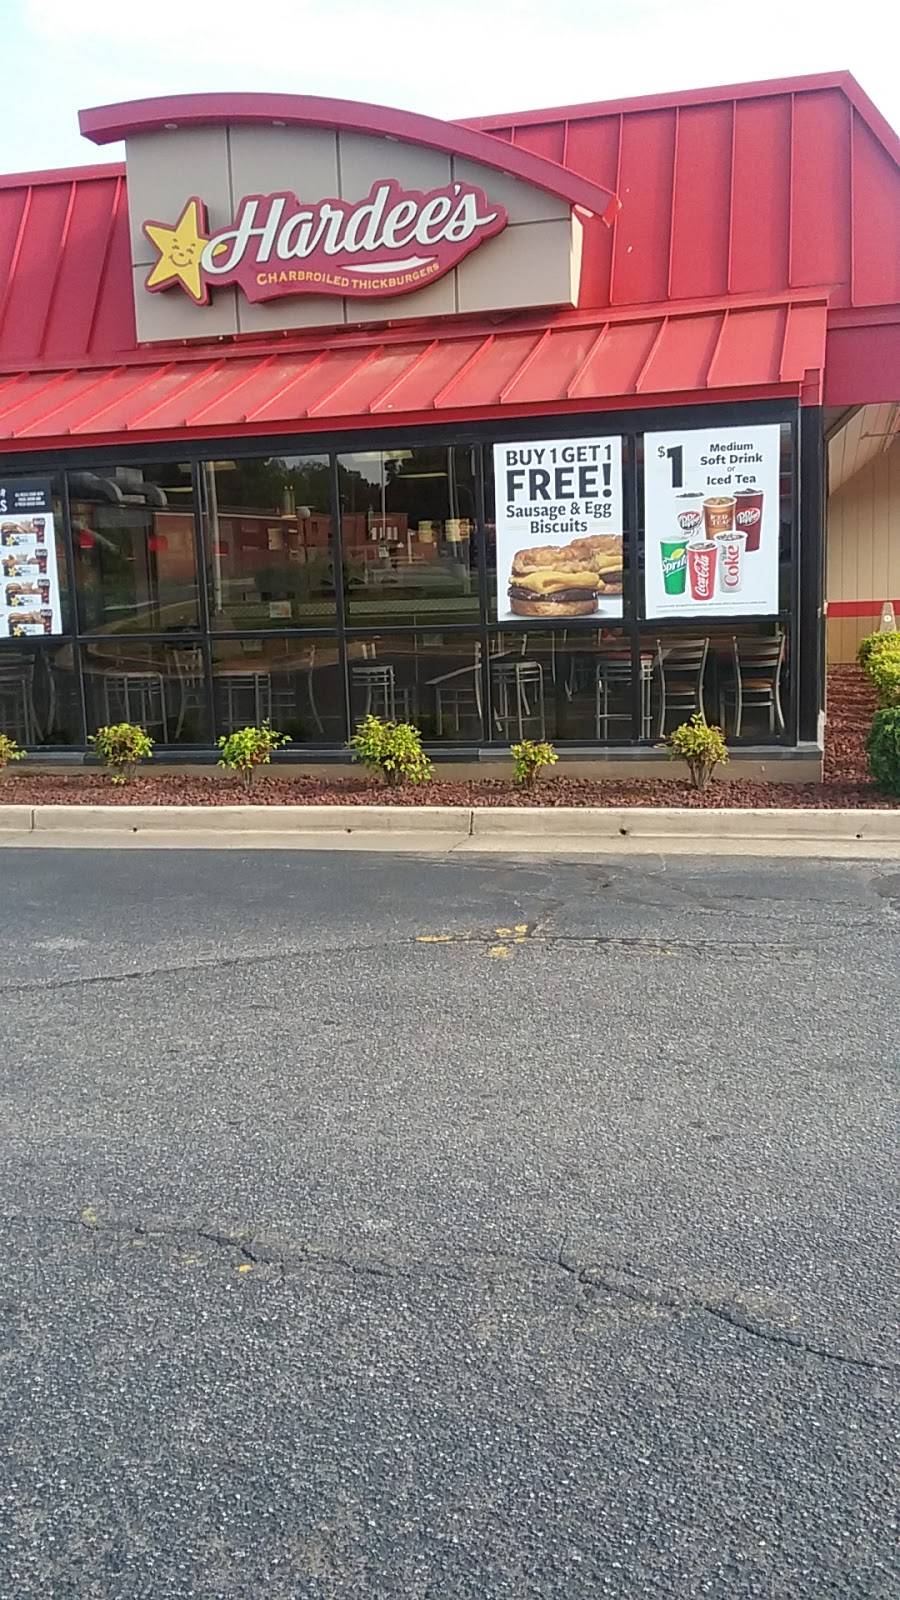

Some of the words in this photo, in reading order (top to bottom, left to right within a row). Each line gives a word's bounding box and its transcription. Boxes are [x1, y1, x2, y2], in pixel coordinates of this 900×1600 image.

[201, 183, 497, 274] Hardee's
[256, 270, 349, 287] CHARBROILED
[351, 263, 440, 289] THICKBURGERS
[506, 448, 545, 466] BUY
[549, 448, 557, 464] 1
[561, 444, 601, 463] GET
[604, 444, 612, 461] 1
[709, 441, 754, 452] Medium
[700, 455, 726, 466] Soft
[729, 453, 763, 464] Drink
[506, 463, 612, 502] FREE!
[706, 474, 732, 485] Iced
[735, 474, 757, 484] Tea
[0, 499, 7, 512] S
[506, 504, 566, 520] Sausage
[570, 501, 580, 515] &
[585, 501, 612, 519] Egg
[530, 518, 588, 534] Biscuits
[724, 544, 739, 587] Coke
